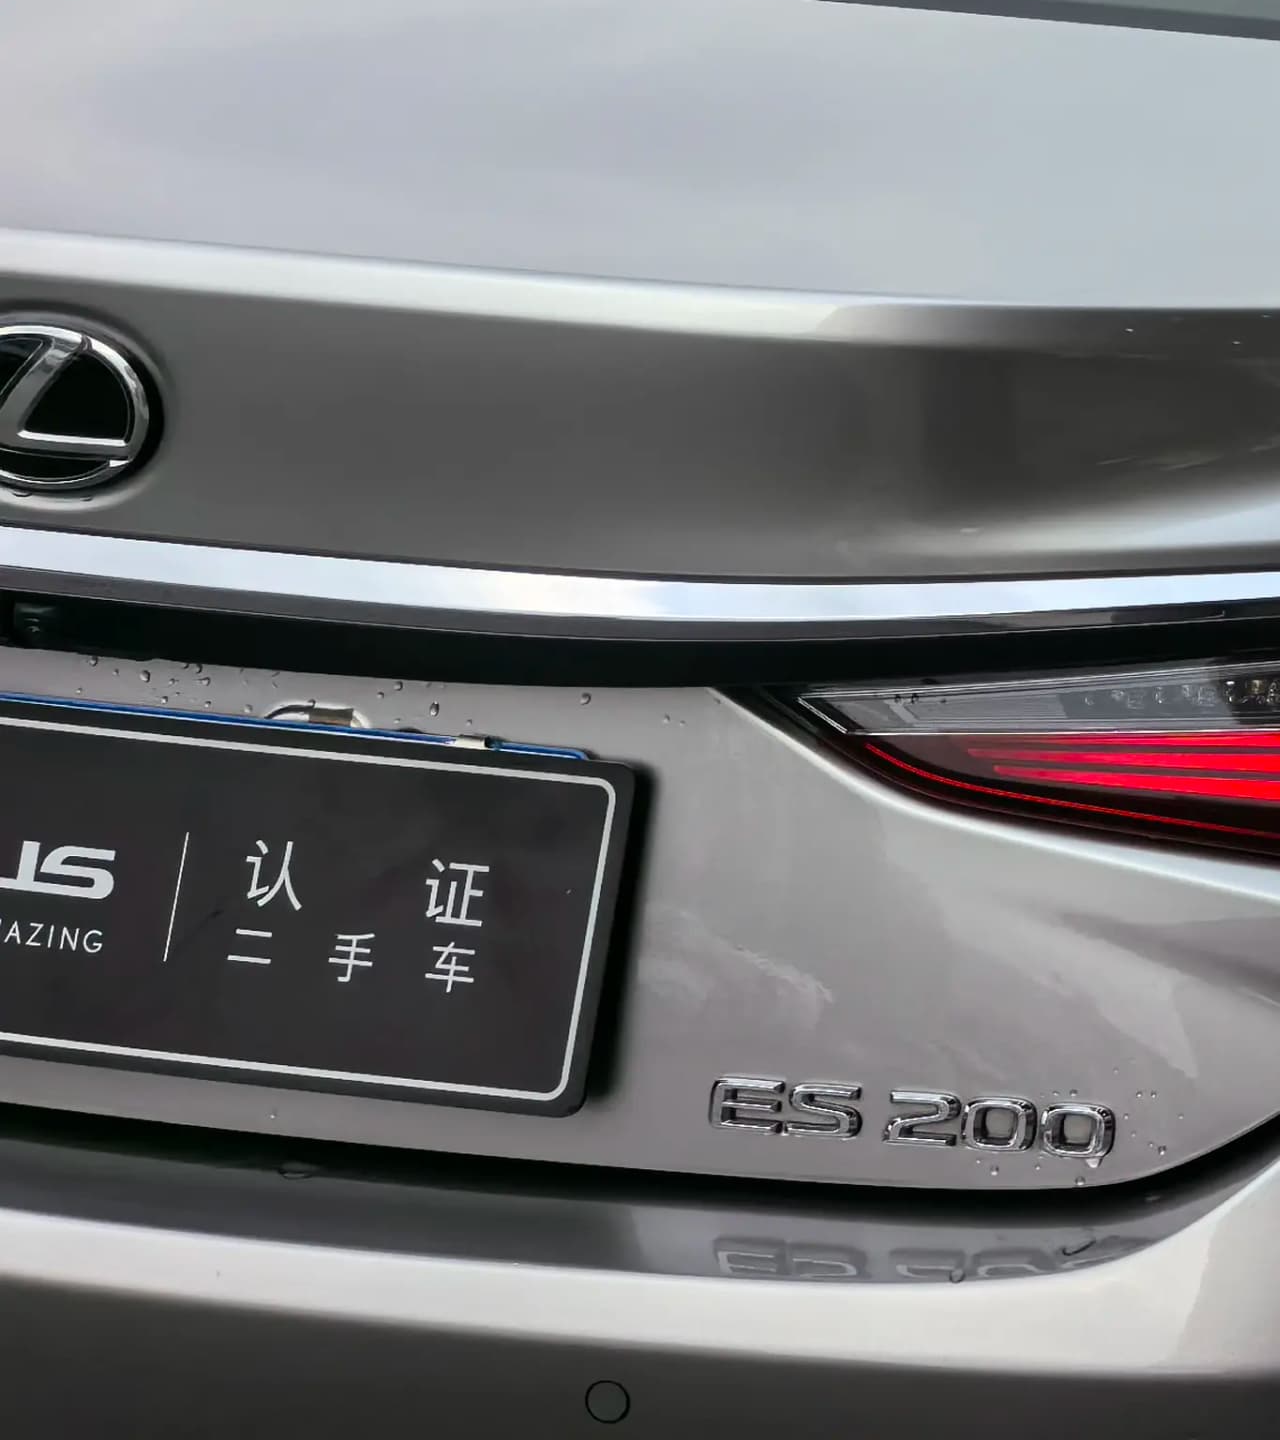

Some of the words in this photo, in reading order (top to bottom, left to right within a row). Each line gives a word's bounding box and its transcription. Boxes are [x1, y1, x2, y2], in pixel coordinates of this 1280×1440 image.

[0, 918, 104, 953] AZING
[226, 926, 477, 994] 二手车
[708, 1073, 864, 1139] ES
[882, 1088, 1117, 1159] 200
